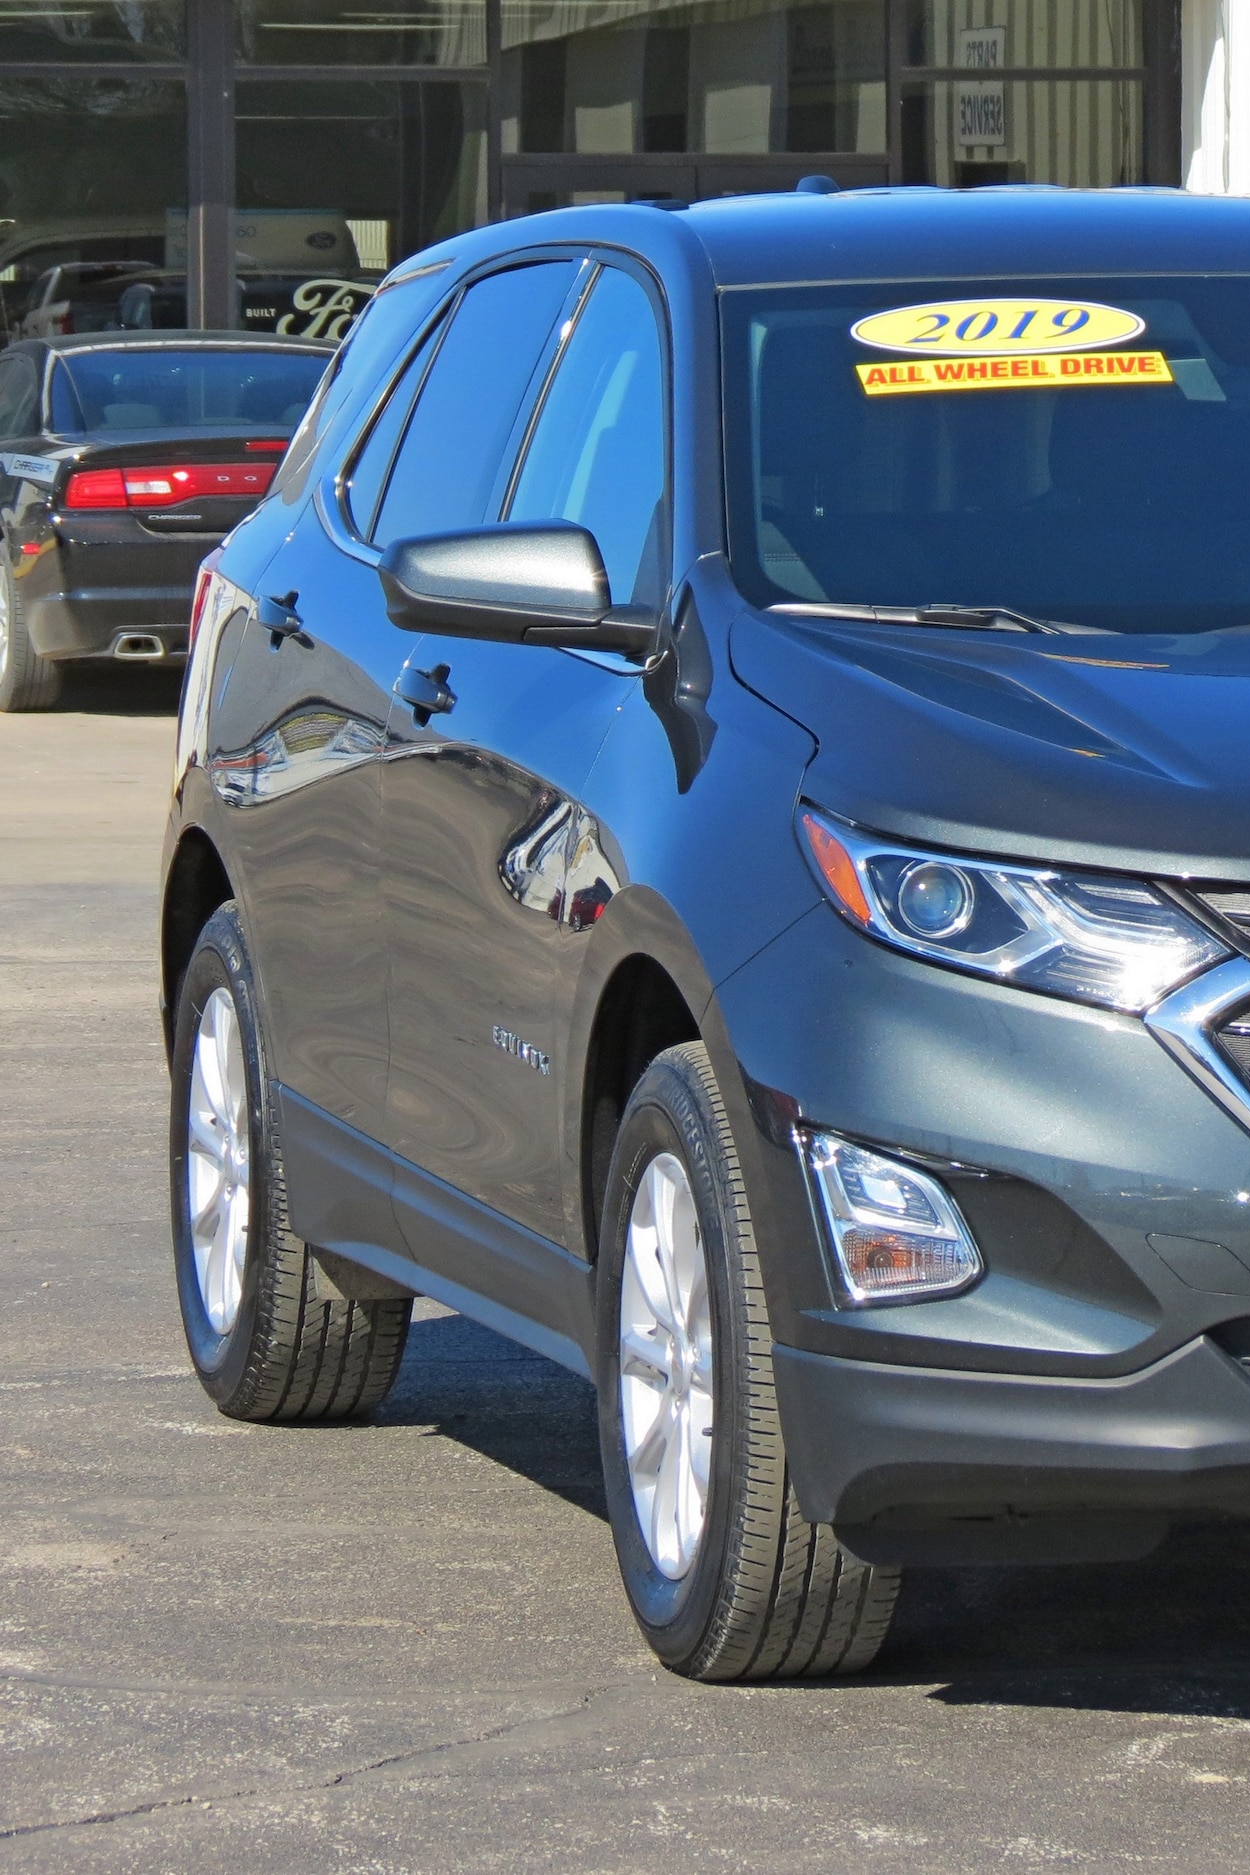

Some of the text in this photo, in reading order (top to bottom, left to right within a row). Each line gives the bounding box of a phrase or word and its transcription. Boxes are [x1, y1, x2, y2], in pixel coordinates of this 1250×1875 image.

[245, 308, 277, 318] BUILT
[904, 308, 1091, 344] 2019
[865, 356, 1160, 388] ALL WHEEL DRIVE
